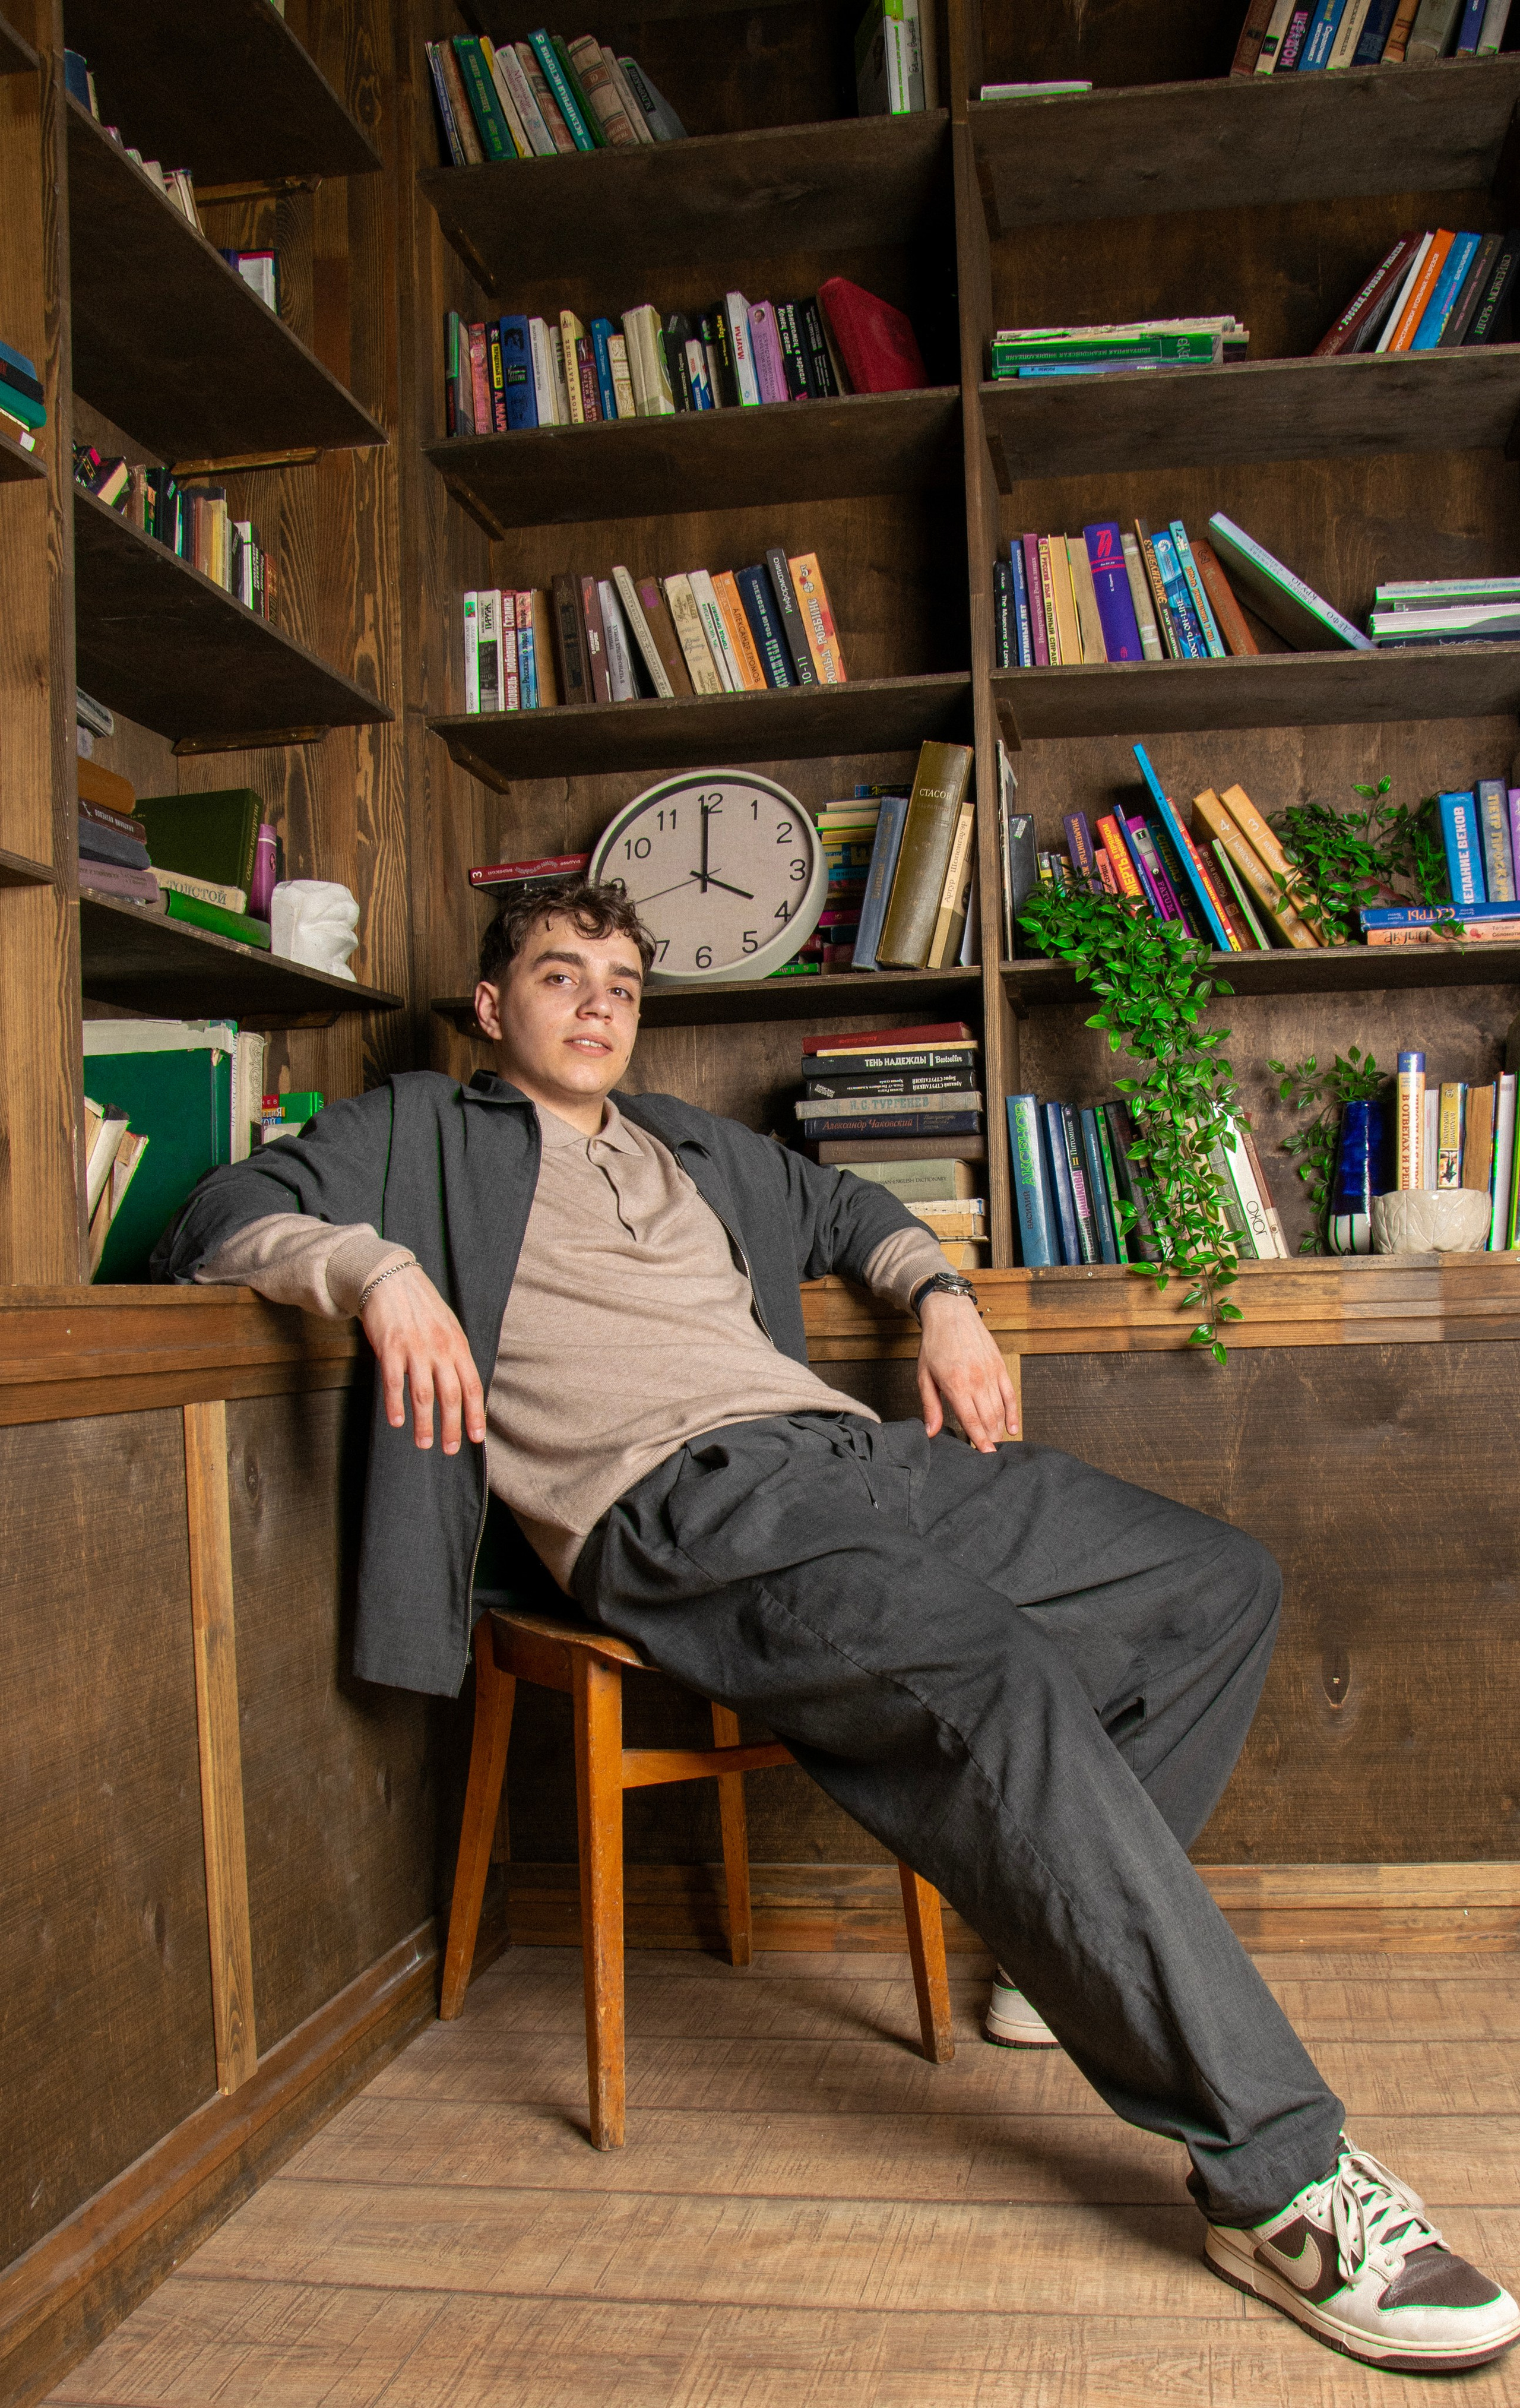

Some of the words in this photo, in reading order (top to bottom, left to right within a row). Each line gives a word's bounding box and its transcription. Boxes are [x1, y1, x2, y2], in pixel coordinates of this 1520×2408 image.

[540, 45, 562, 86] ИСТОРИЯ
[557, 84, 584, 135] ВСЕМИРНАЯ
[777, 308, 787, 330] Конец
[782, 332, 791, 354] света
[786, 305, 799, 347] Незнакомец
[795, 356, 806, 385] зеркале
[565, 339, 574, 382] БАТЮШКЕ
[772, 556, 793, 614] Информатика
[1290, 575, 1318, 600] КРУЗО
[502, 597, 514, 627] Сталина
[751, 579, 765, 615] АЛЕКСЕЙ
[761, 616, 772, 638] ЮГОВ
[807, 597, 827, 644] РОББИНС
[1034, 594, 1044, 643] Императорский
[1325, 610, 1351, 634] ДЕФО
[504, 630, 517, 672] любовницы
[718, 630, 729, 650] ГОРОД
[1021, 620, 1031, 667] БЕЗУМНЫХ
[521, 656, 530, 683] Рассказы
[797, 656, 812, 684] 10-11
[506, 676, 518, 709] Исповедь
[698, 793, 723, 814] 12
[751, 800, 758, 819] 1
[1487, 794, 1502, 828] ПЕТР
[657, 809, 676, 830] 11
[777, 822, 791, 843] 2
[1454, 806, 1468, 849] ВЕКОВ
[625, 838, 651, 859] 10
[1071, 818, 1087, 865] ЗНАМЕНИТЫЕ
[1102, 823, 1117, 853] ПРЯМОМ
[1113, 832, 1126, 857] ЭФИРЕ
[790, 859, 805, 880] 3
[944, 879, 955, 903] Артур
[950, 821, 967, 872] Шопенгауэр
[1157, 880, 1175, 913] FATUM
[1202, 877, 1217, 900] ПОДВИГИ
[774, 900, 790, 921] 4
[742, 931, 758, 953] 5
[696, 947, 711, 967] 6
[864, 1059, 884, 1067] ТЕНЬ
[884, 1056, 926, 1066] НАДЕЖДЫ
[935, 1055, 962, 1064] Bestseller
[872, 1097, 929, 1109] ТУРГЕНЕВ
[822, 1121, 867, 1131] Александр
[869, 1119, 913, 1128] Чаковский
